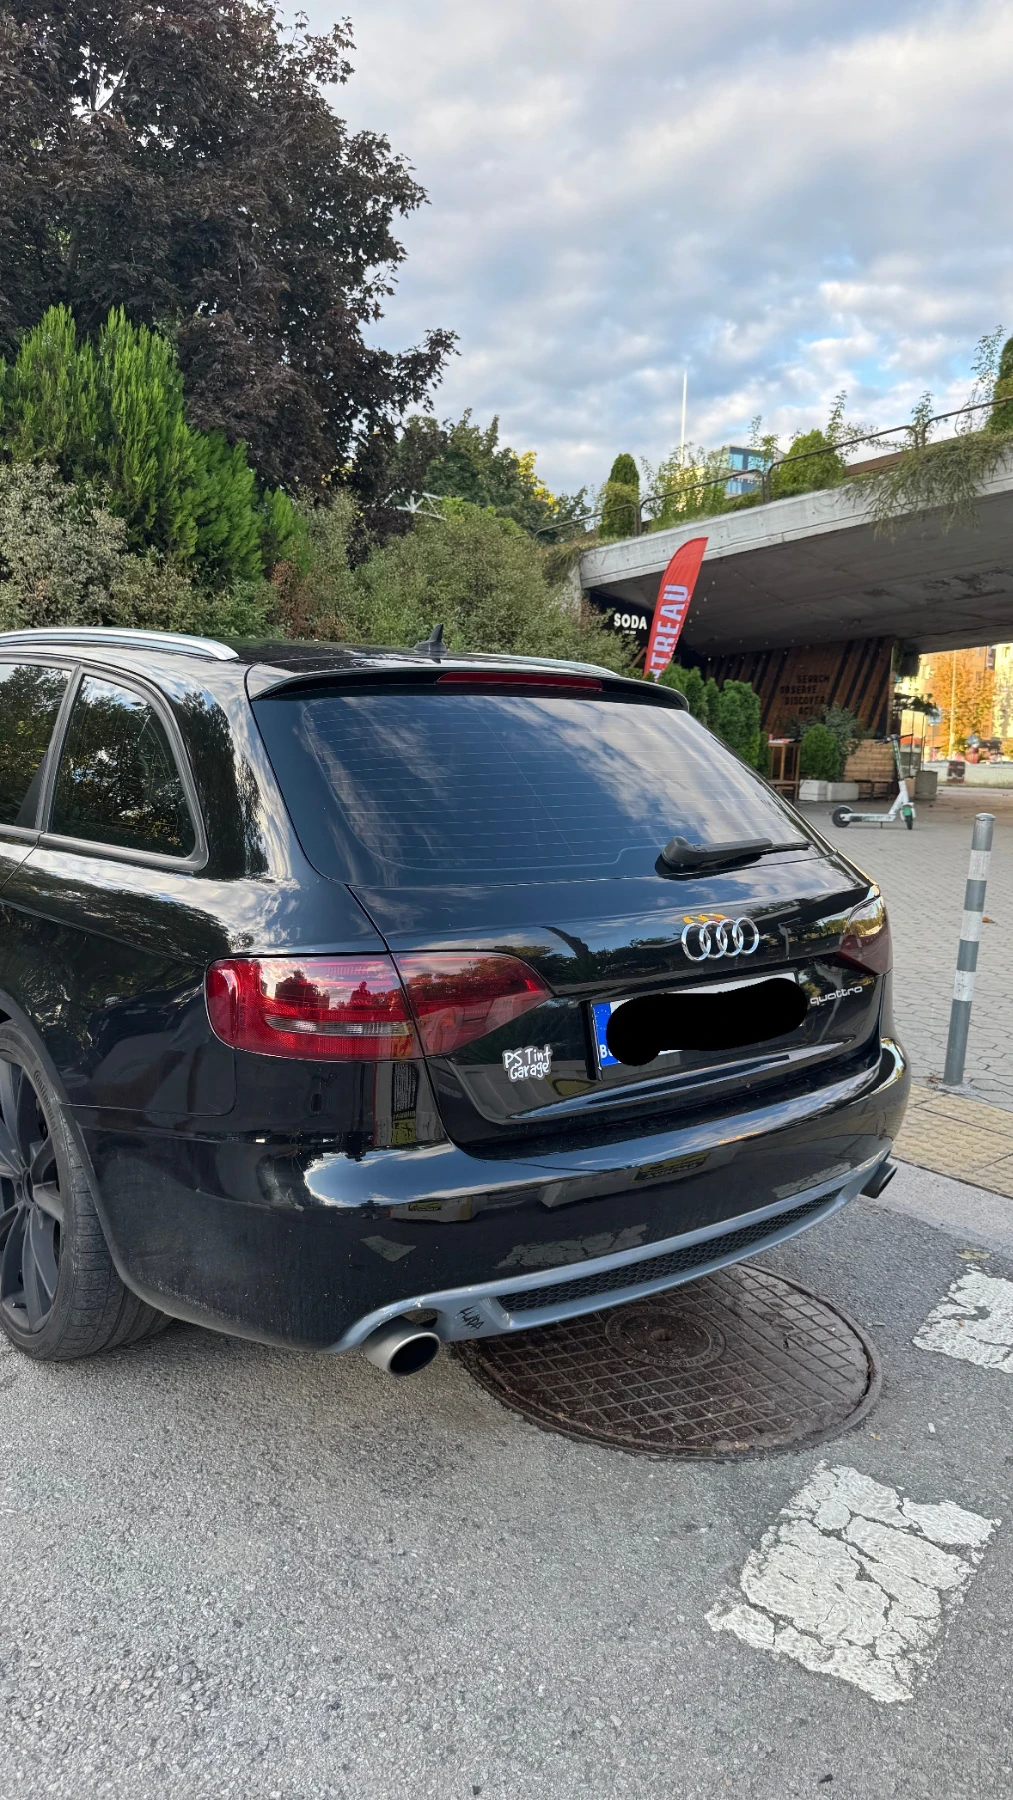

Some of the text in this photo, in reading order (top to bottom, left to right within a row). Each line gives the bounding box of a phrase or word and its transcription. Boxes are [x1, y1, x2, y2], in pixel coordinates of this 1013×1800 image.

[613, 612, 648, 630] SODA
[797, 674, 830, 683] SEARCH
[780, 685, 818, 694] OBSERVE
[784, 696, 826, 705] DISCOVER
[810, 986, 863, 1005] quattro
[504, 1046, 551, 1068] PS Tint
[510, 1062, 550, 1079] Garage
[34, 1070, 58, 1131] Continental
